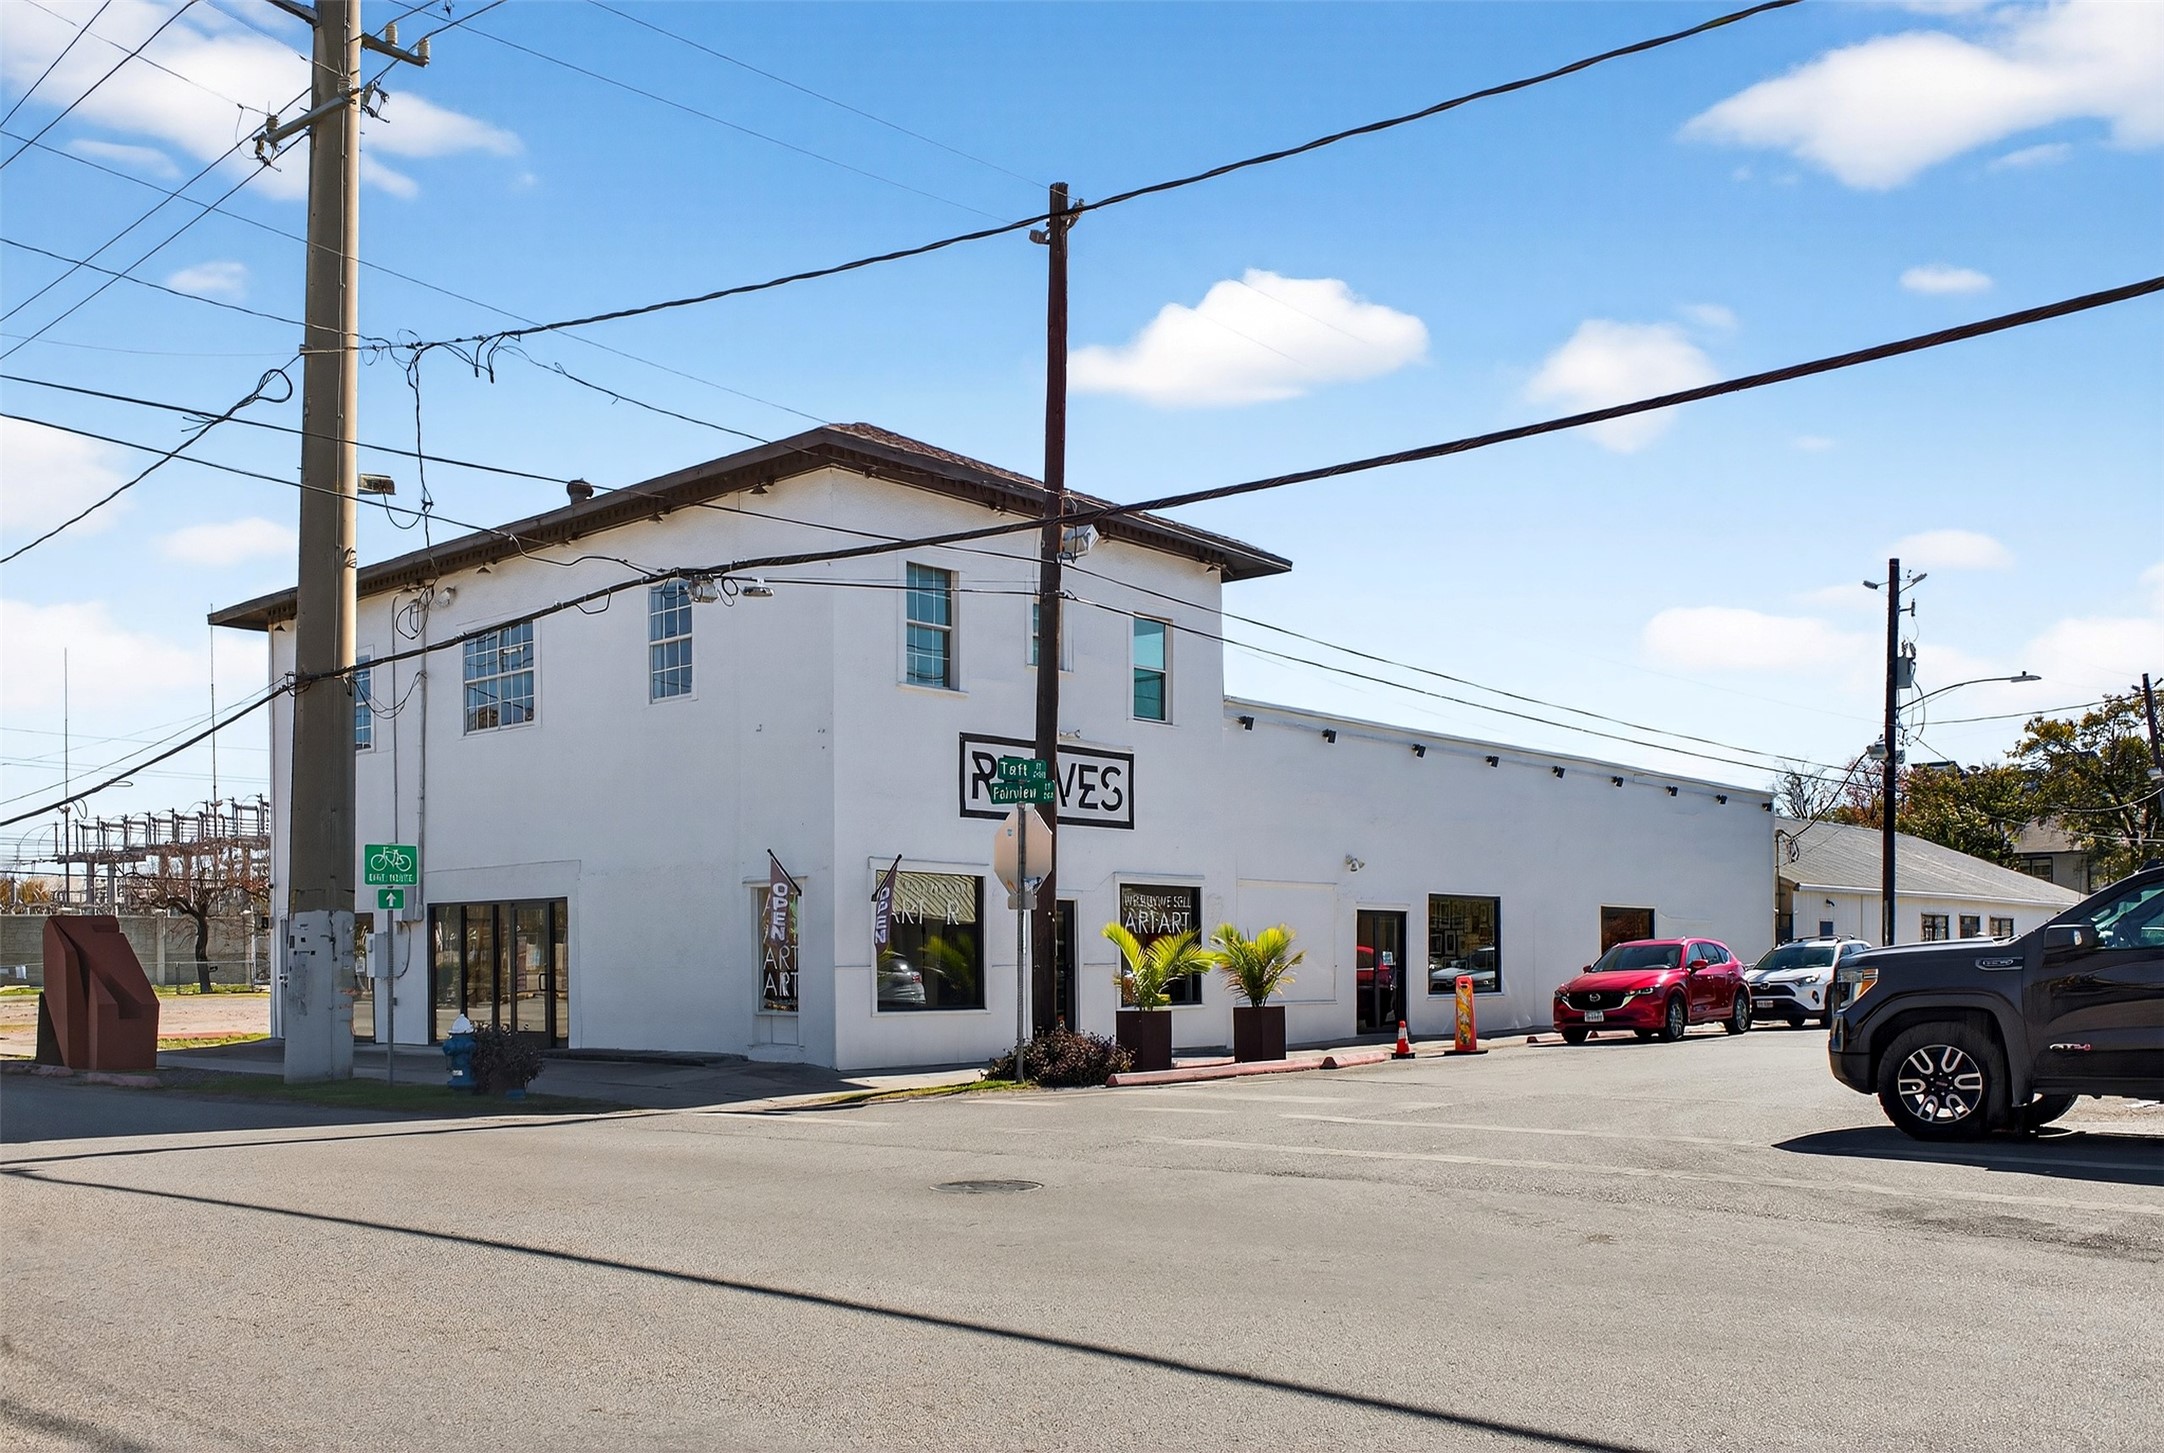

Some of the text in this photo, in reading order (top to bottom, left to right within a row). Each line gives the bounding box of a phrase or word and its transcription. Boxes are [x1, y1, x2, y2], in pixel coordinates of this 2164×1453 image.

[972, 751, 1123, 811] RVES
[1000, 761, 1028, 776] Taft
[993, 785, 1037, 801] Fairview
[771, 882, 789, 941] OPEN
[875, 886, 890, 944] OPEN
[1124, 910, 1190, 934] ART ART
[763, 945, 798, 970] ART
[763, 972, 798, 997] ART
